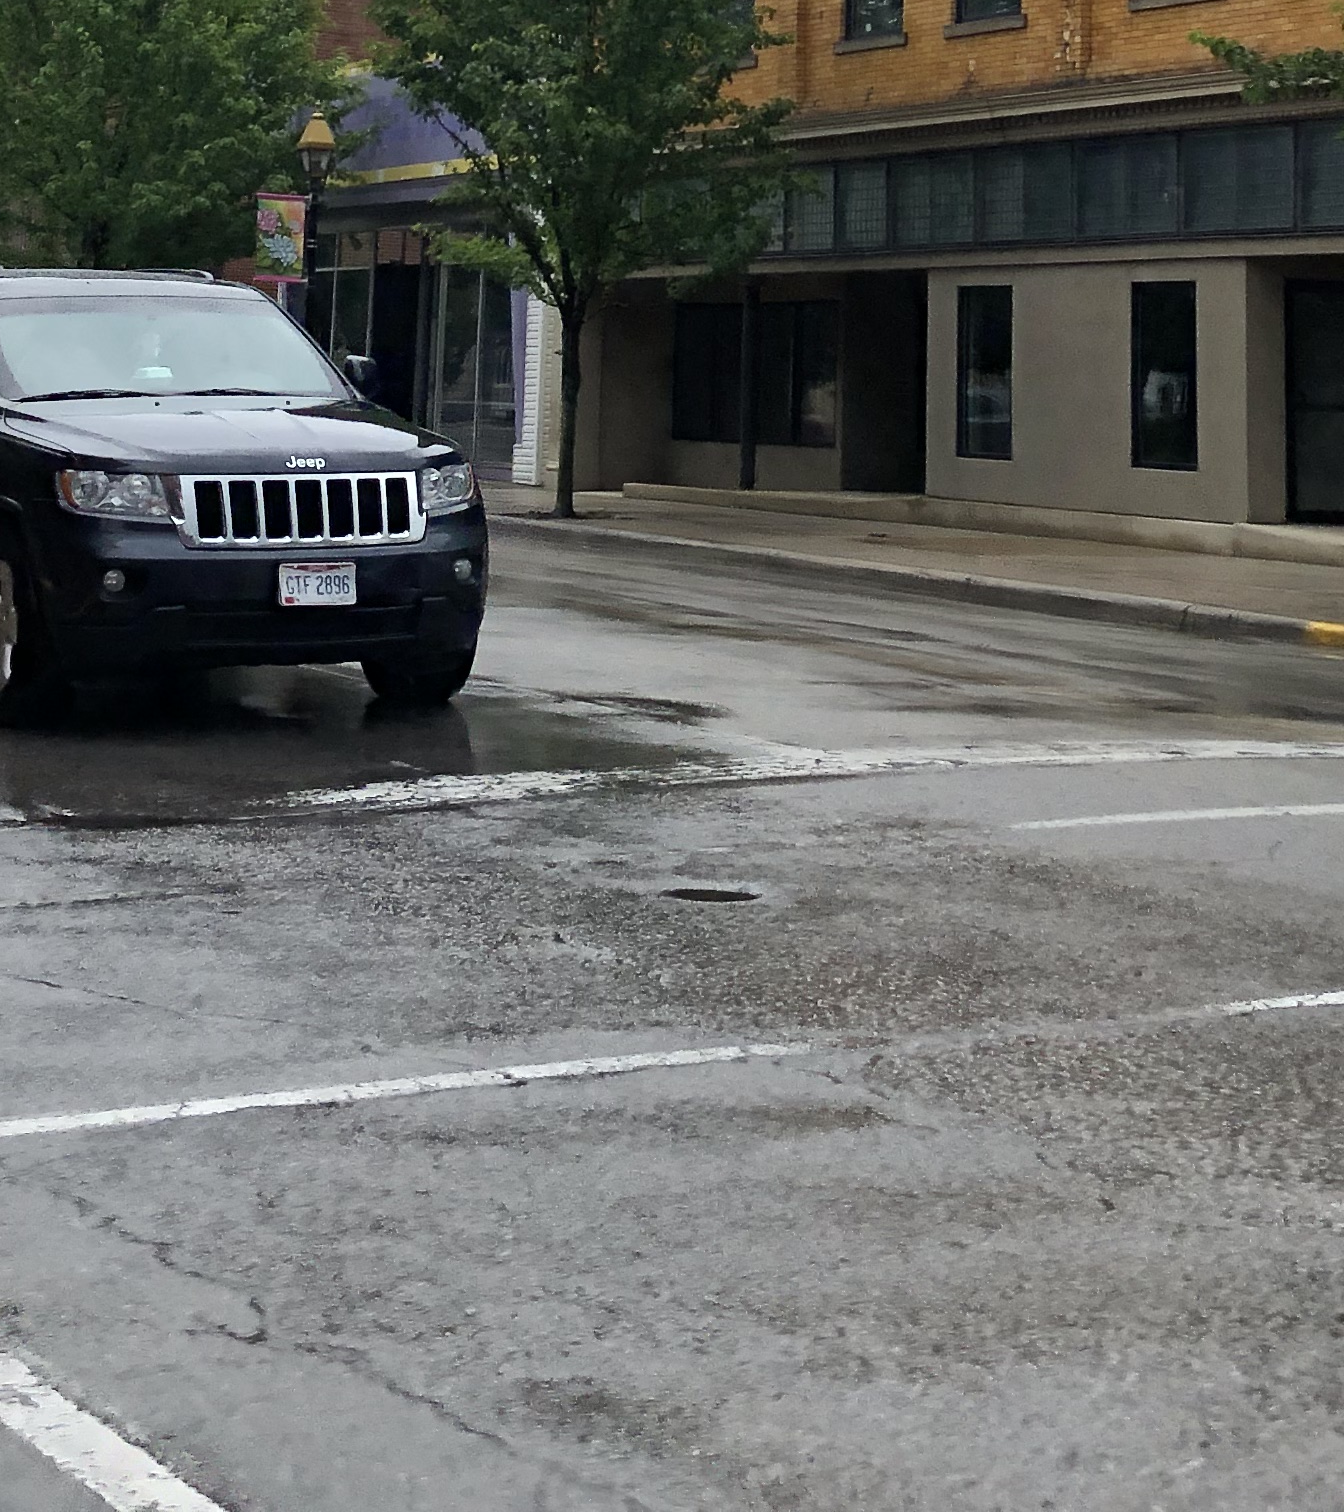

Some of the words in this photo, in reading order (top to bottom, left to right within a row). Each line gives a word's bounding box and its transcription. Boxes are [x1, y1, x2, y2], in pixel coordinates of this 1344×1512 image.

[285, 455, 326, 470] Jeep
[285, 574, 312, 596] GTF
[315, 574, 351, 596] 2896
